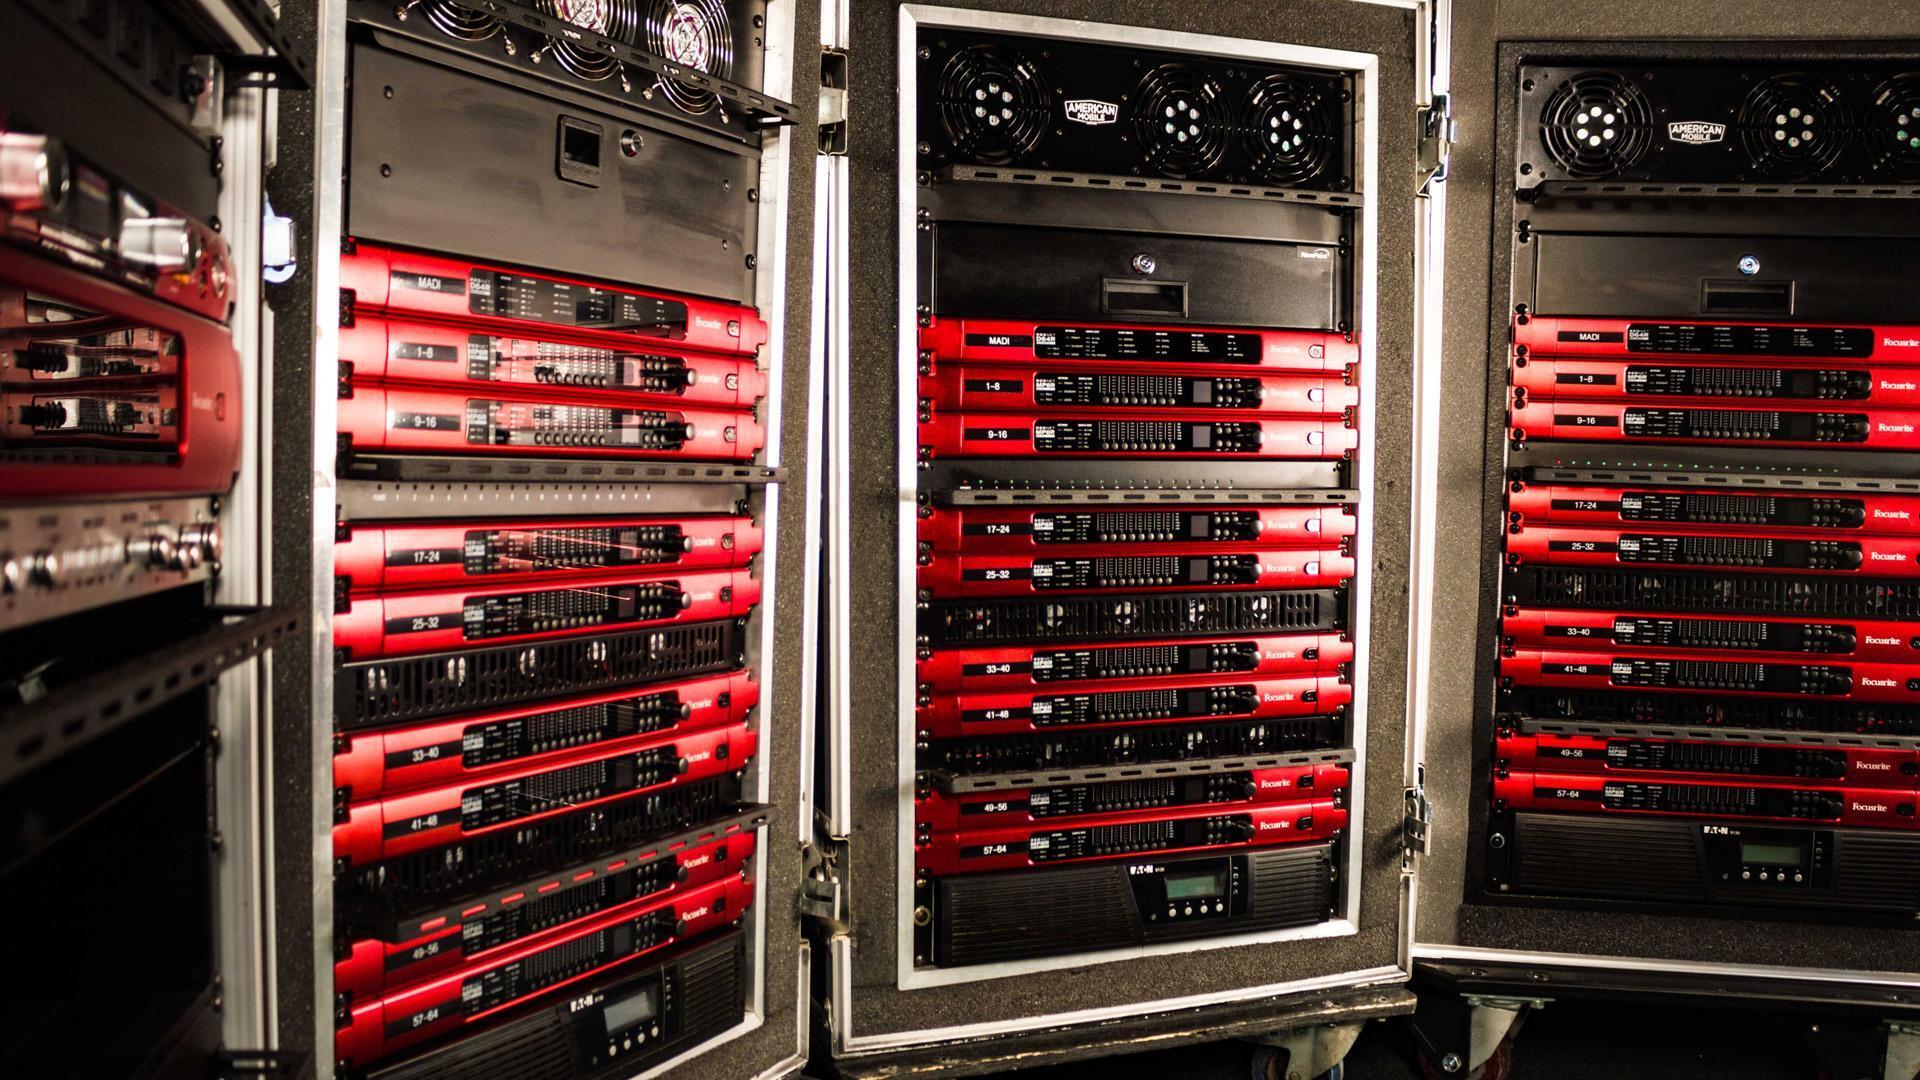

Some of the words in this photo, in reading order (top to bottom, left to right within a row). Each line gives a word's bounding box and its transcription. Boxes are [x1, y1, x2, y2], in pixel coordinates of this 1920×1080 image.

[1068, 102, 1115, 115] AMERICAN
[1077, 112, 1106, 121] MOBILE
[1671, 124, 1722, 135] AMERICAN
[418, 277, 441, 290] MADI
[989, 336, 1010, 345] MADI
[1579, 333, 1600, 341] MADI
[1883, 338, 1920, 347] Focusrite
[417, 347, 433, 358] 1-8
[1579, 375, 1593, 383] 1-8
[986, 382, 1000, 390] 1-8
[1881, 381, 1916, 390] Focusrite
[414, 415, 437, 428] 9-16
[1878, 424, 1914, 432] Focusrite
[988, 431, 1008, 439] 9-16
[1874, 510, 1910, 518] Focusrite
[987, 525, 1010, 534] 17-24
[1572, 543, 1595, 551] 25-32
[414, 551, 440, 563] 17-24
[1871, 552, 1906, 560] Focusrite
[986, 570, 1009, 579] 25-32
[412, 617, 439, 630] 25-32
[1567, 628, 1590, 636] 33-40
[1865, 636, 1901, 645] Focusrite
[1266, 651, 1295, 659] Focusrite
[987, 664, 1010, 674] 33-40
[1862, 678, 1897, 686] Focusrite
[1264, 693, 1294, 702] Focusrite
[985, 710, 1009, 719] 41-48
[412, 747, 439, 762] 33-40
[1561, 749, 1583, 757] 49-56
[1856, 761, 1891, 770] Focusrite
[1261, 779, 1291, 788] Focusrite
[1557, 790, 1579, 798] 57-64
[984, 803, 1008, 812] 49-56
[1852, 803, 1887, 812] Focusrite
[411, 815, 438, 830] 41-48
[1260, 821, 1289, 830] Focusrite
[984, 846, 1007, 855] 57-64
[682, 906, 708, 921] Focusrite
[413, 942, 439, 959] 49-56
[412, 1008, 439, 1027] 57-64
